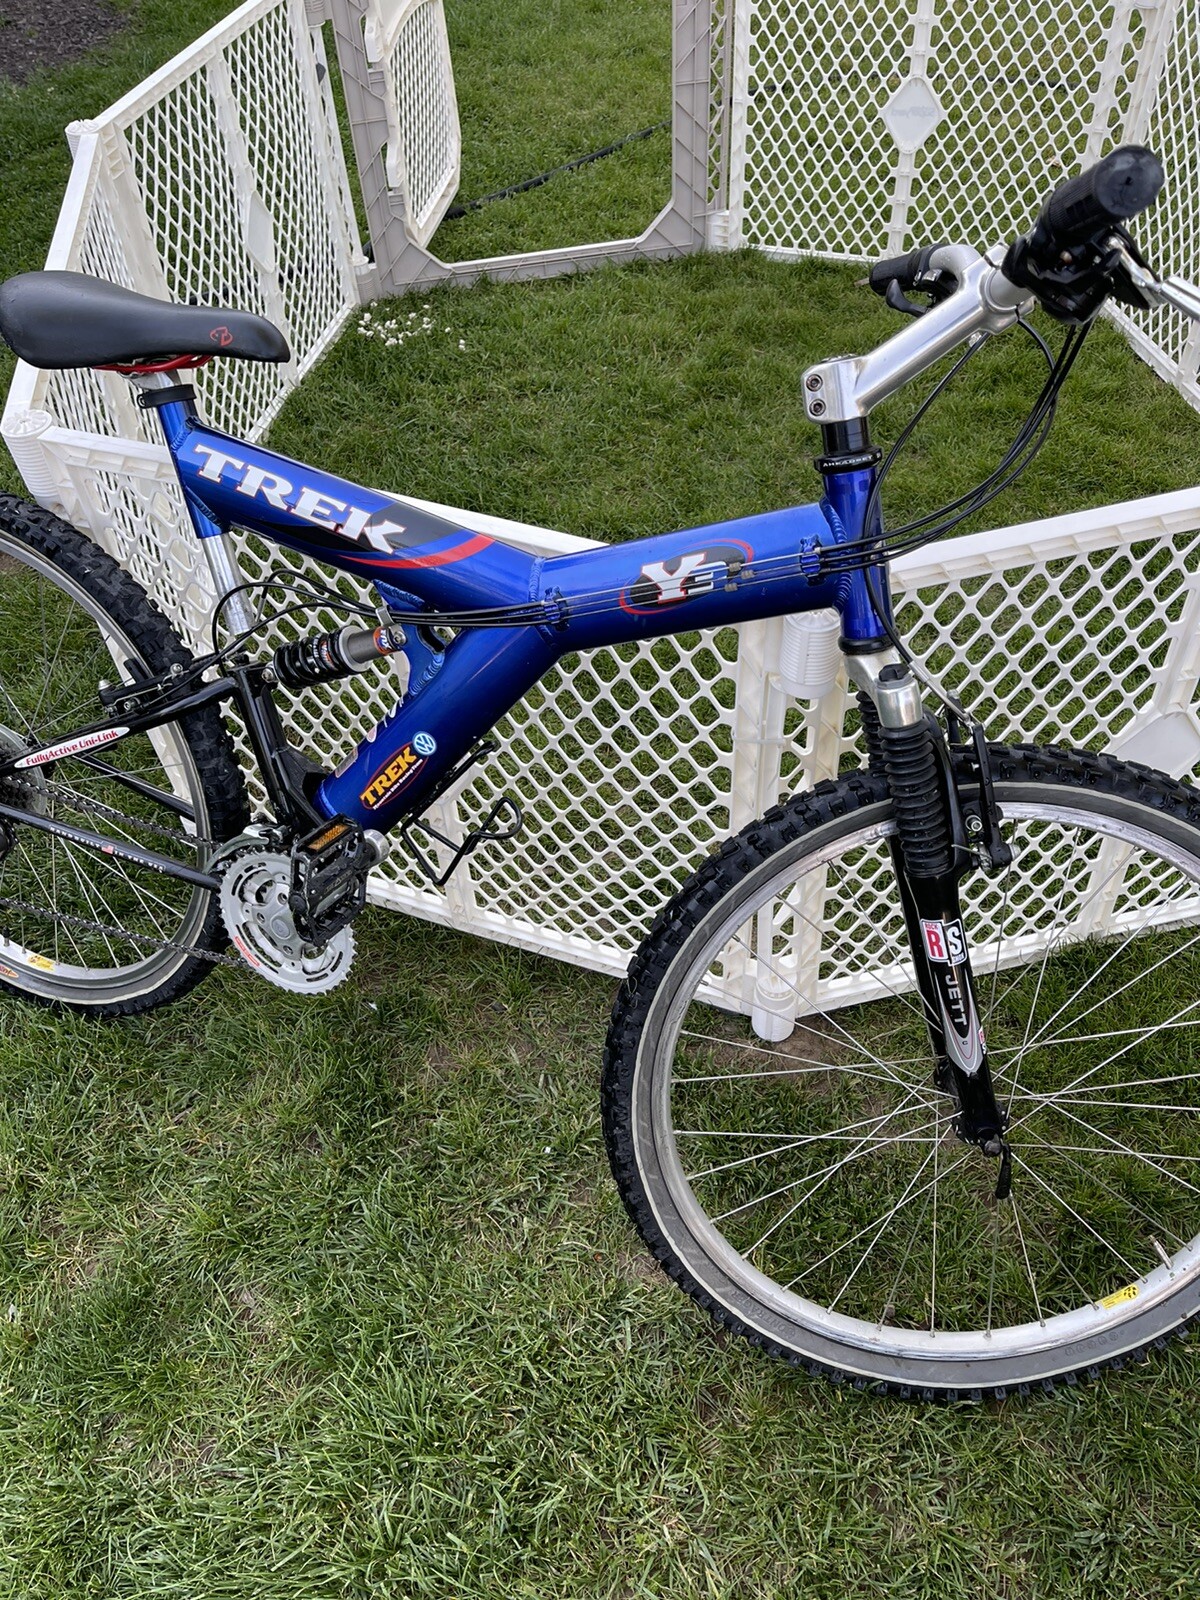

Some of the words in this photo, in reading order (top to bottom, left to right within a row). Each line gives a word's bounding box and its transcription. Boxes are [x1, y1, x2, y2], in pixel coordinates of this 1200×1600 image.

[195, 444, 406, 554] TREK
[25, 741, 78, 765] FullyActive
[78, 730, 119, 750] Uni-Link
[360, 746, 418, 805] TREK
[945, 974, 967, 1026] JETT
